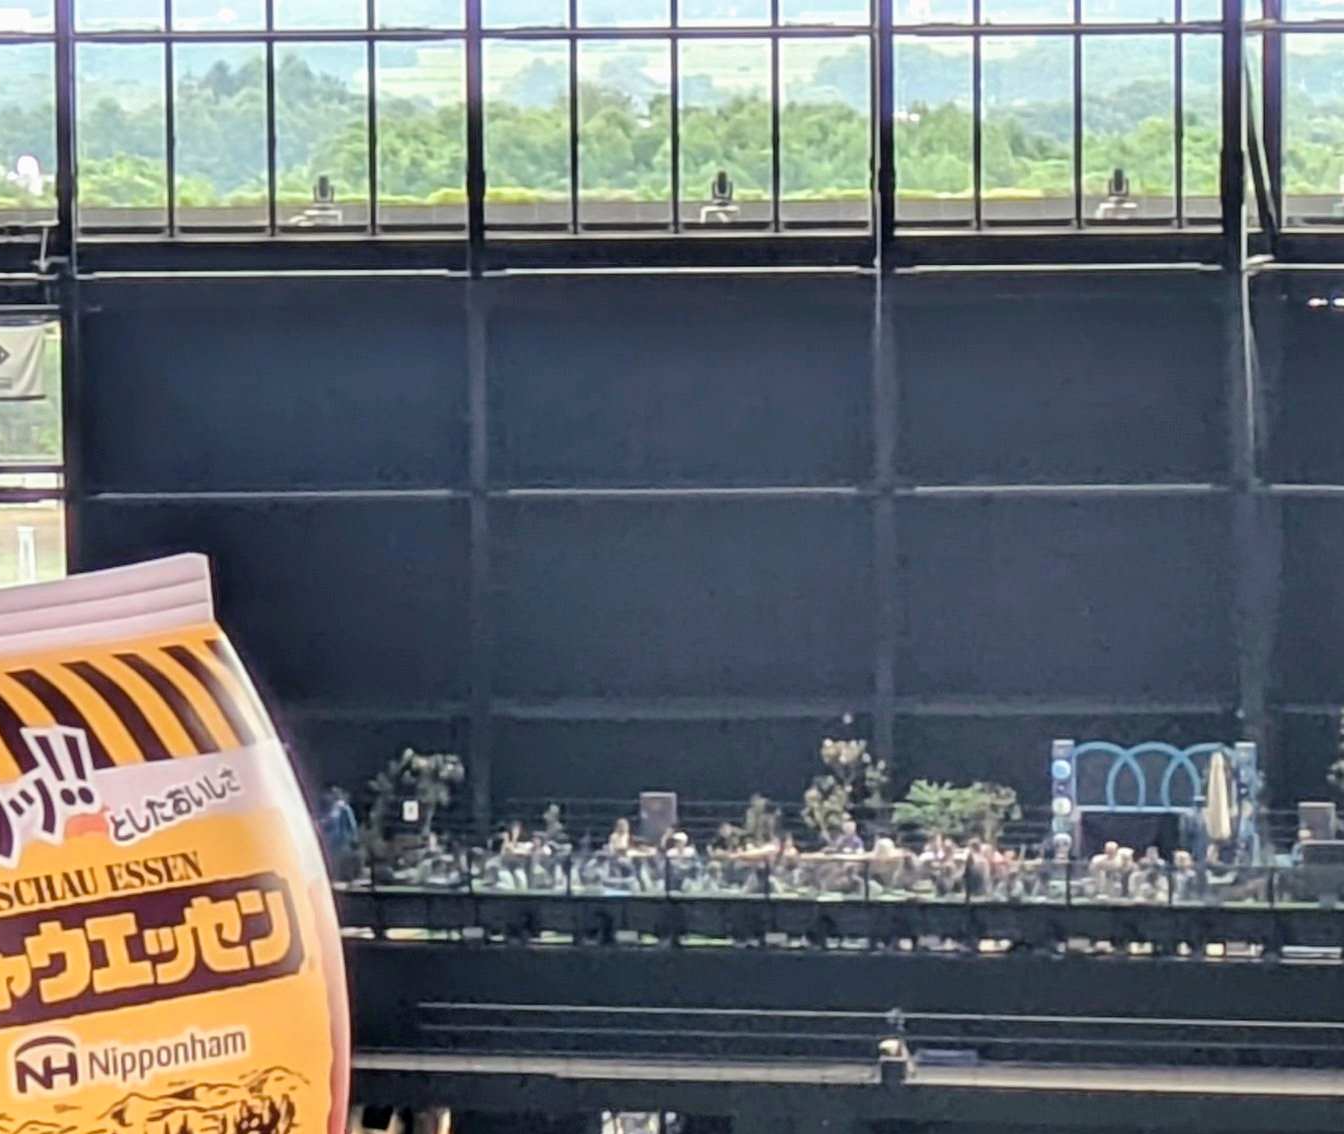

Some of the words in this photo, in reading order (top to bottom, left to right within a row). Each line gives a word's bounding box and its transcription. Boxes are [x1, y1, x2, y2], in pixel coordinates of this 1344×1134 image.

[109, 767, 242, 842] としたおいしさ
[106, 851, 203, 893] ESSEN
[88, 1031, 247, 1083] Nipponham
